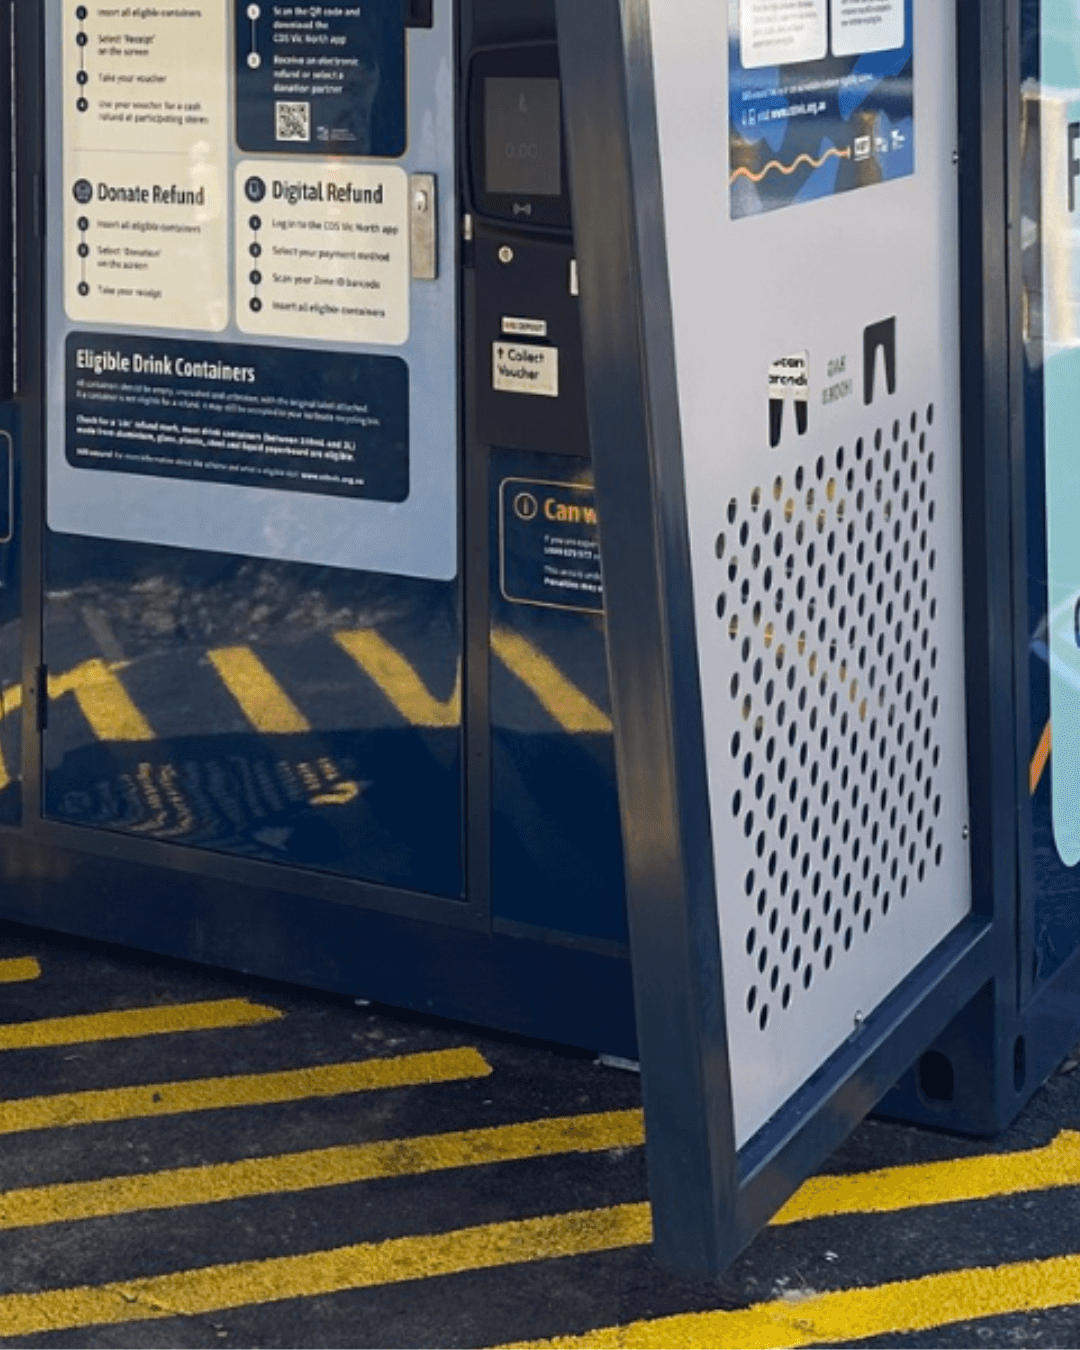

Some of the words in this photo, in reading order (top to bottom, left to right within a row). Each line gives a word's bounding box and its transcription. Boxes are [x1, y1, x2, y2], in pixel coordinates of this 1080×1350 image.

[98, 182, 149, 203] Donate
[153, 184, 205, 205] Refund
[273, 180, 324, 205] Digital
[327, 182, 383, 203] Refund
[76, 349, 130, 374] Eligible
[133, 353, 172, 374] Drink
[175, 358, 255, 383] Containers
[508, 349, 544, 363] Collect
[498, 365, 539, 380] Voucher
[544, 498, 579, 522] Can
